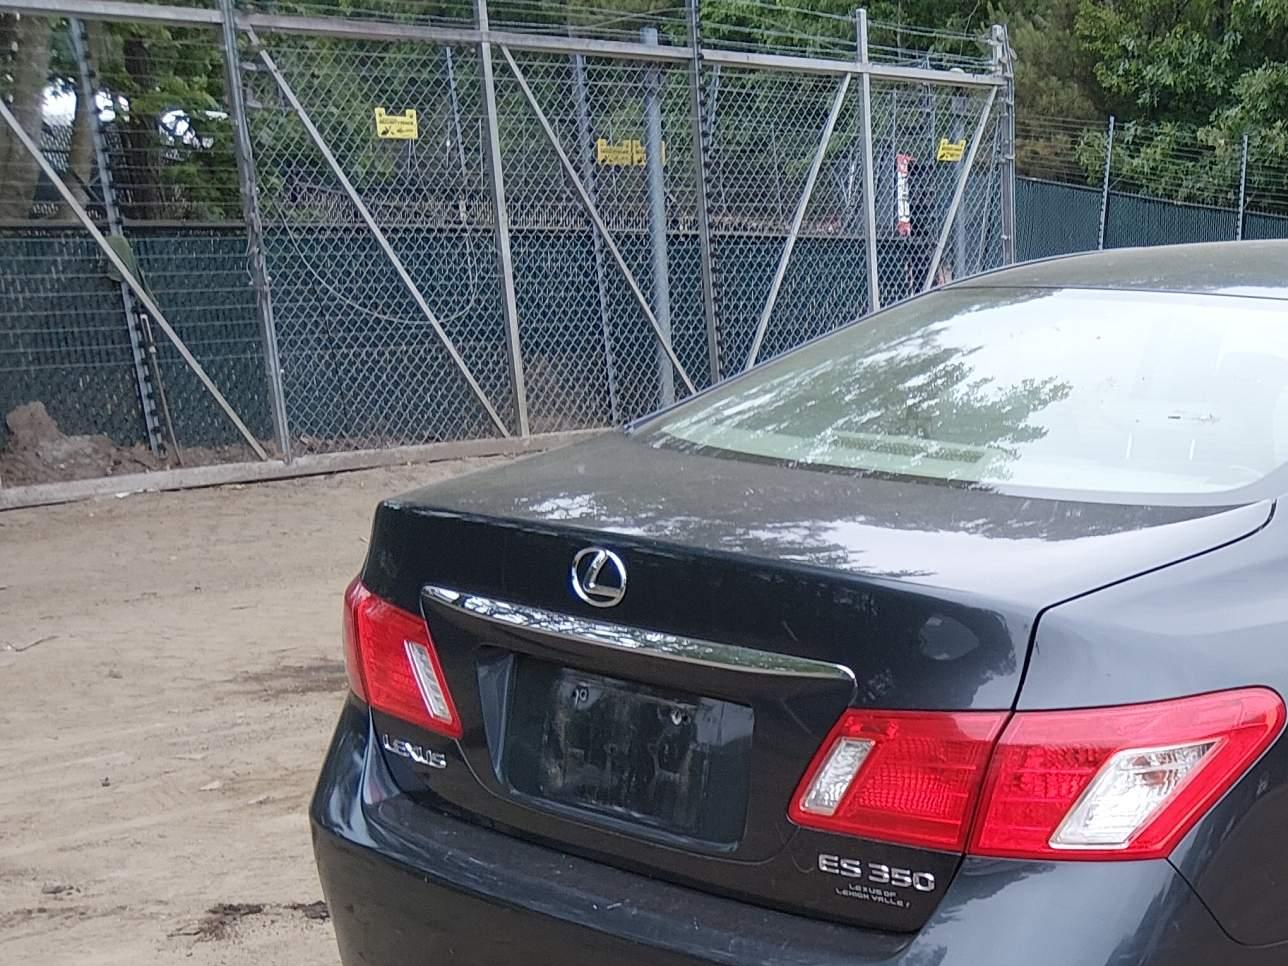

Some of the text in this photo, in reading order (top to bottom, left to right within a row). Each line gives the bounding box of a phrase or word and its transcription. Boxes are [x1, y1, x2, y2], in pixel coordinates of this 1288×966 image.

[383, 734, 447, 768] LEXUS
[818, 854, 935, 892] ES 350
[848, 883, 883, 896] LEXUS
